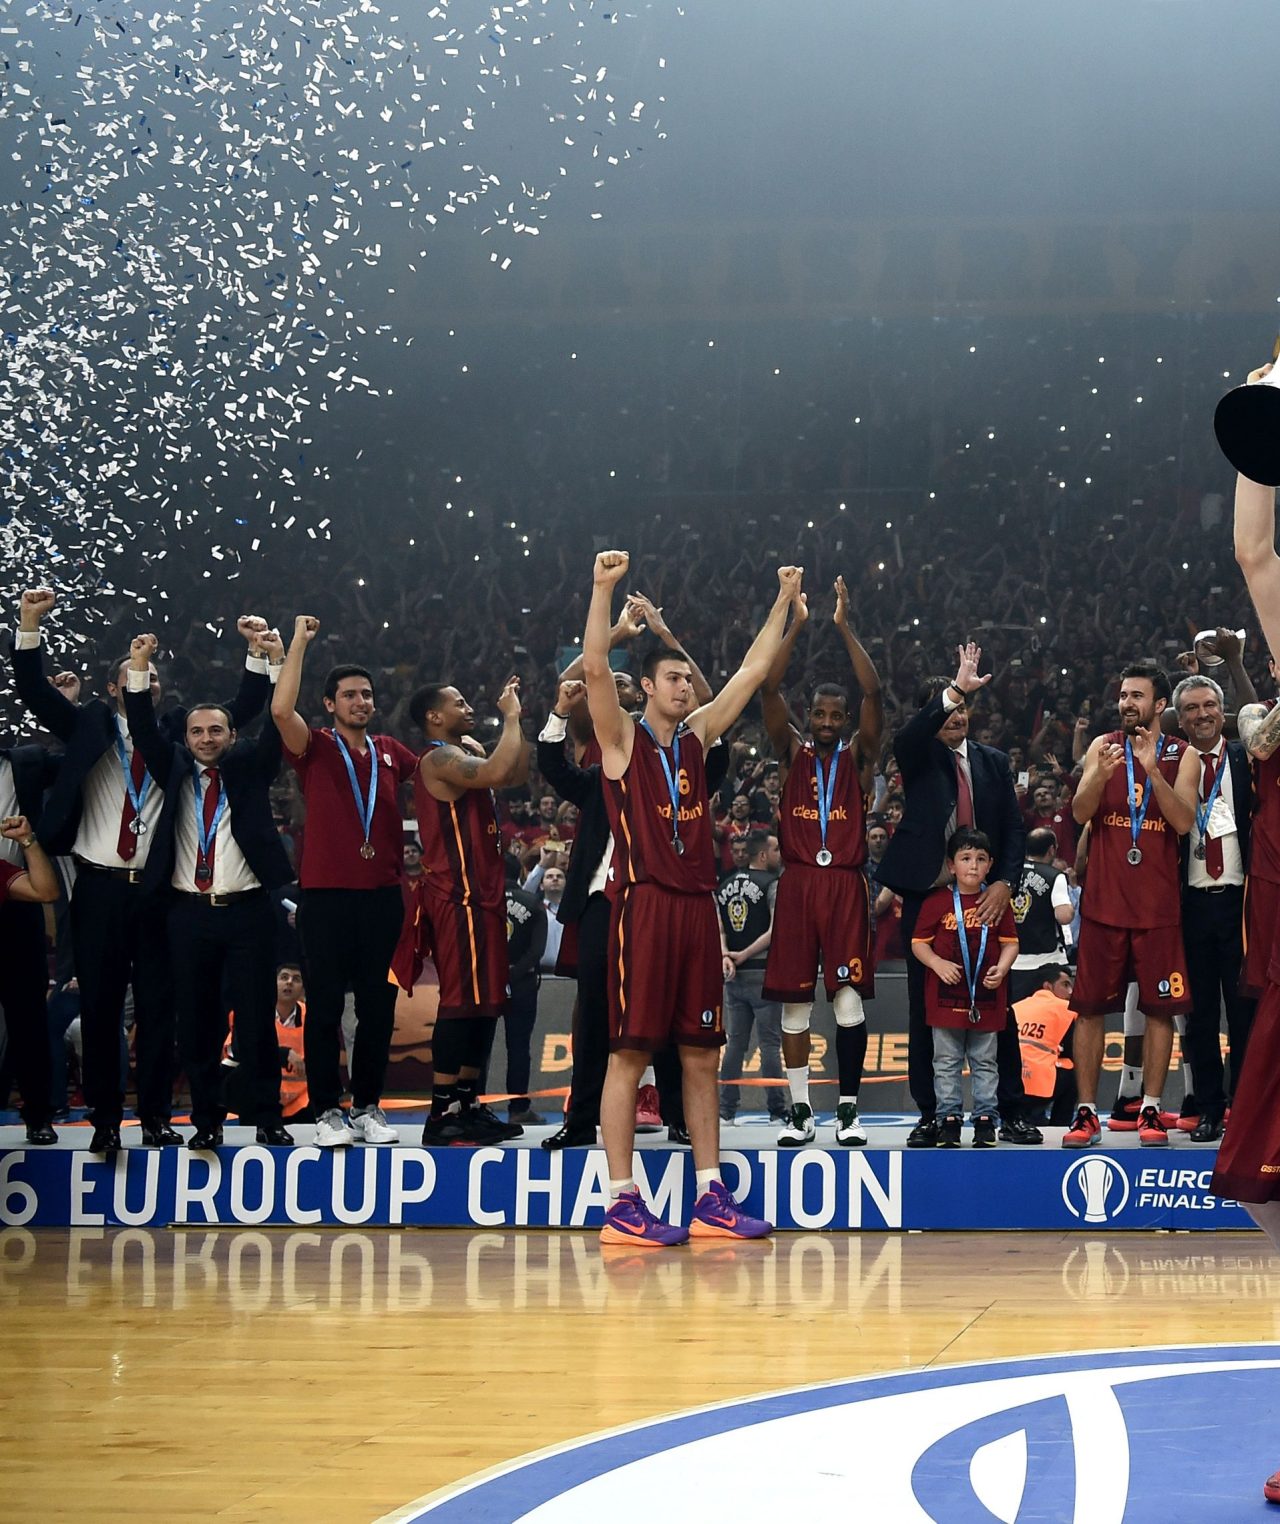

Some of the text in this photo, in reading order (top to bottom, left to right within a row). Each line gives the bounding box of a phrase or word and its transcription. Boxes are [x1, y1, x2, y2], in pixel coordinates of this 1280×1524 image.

[849, 957, 863, 983] 3
[1169, 972, 1184, 998] 8
[70, 1146, 437, 1225] EUROCUP
[1139, 1194, 1216, 1210] FINALS
